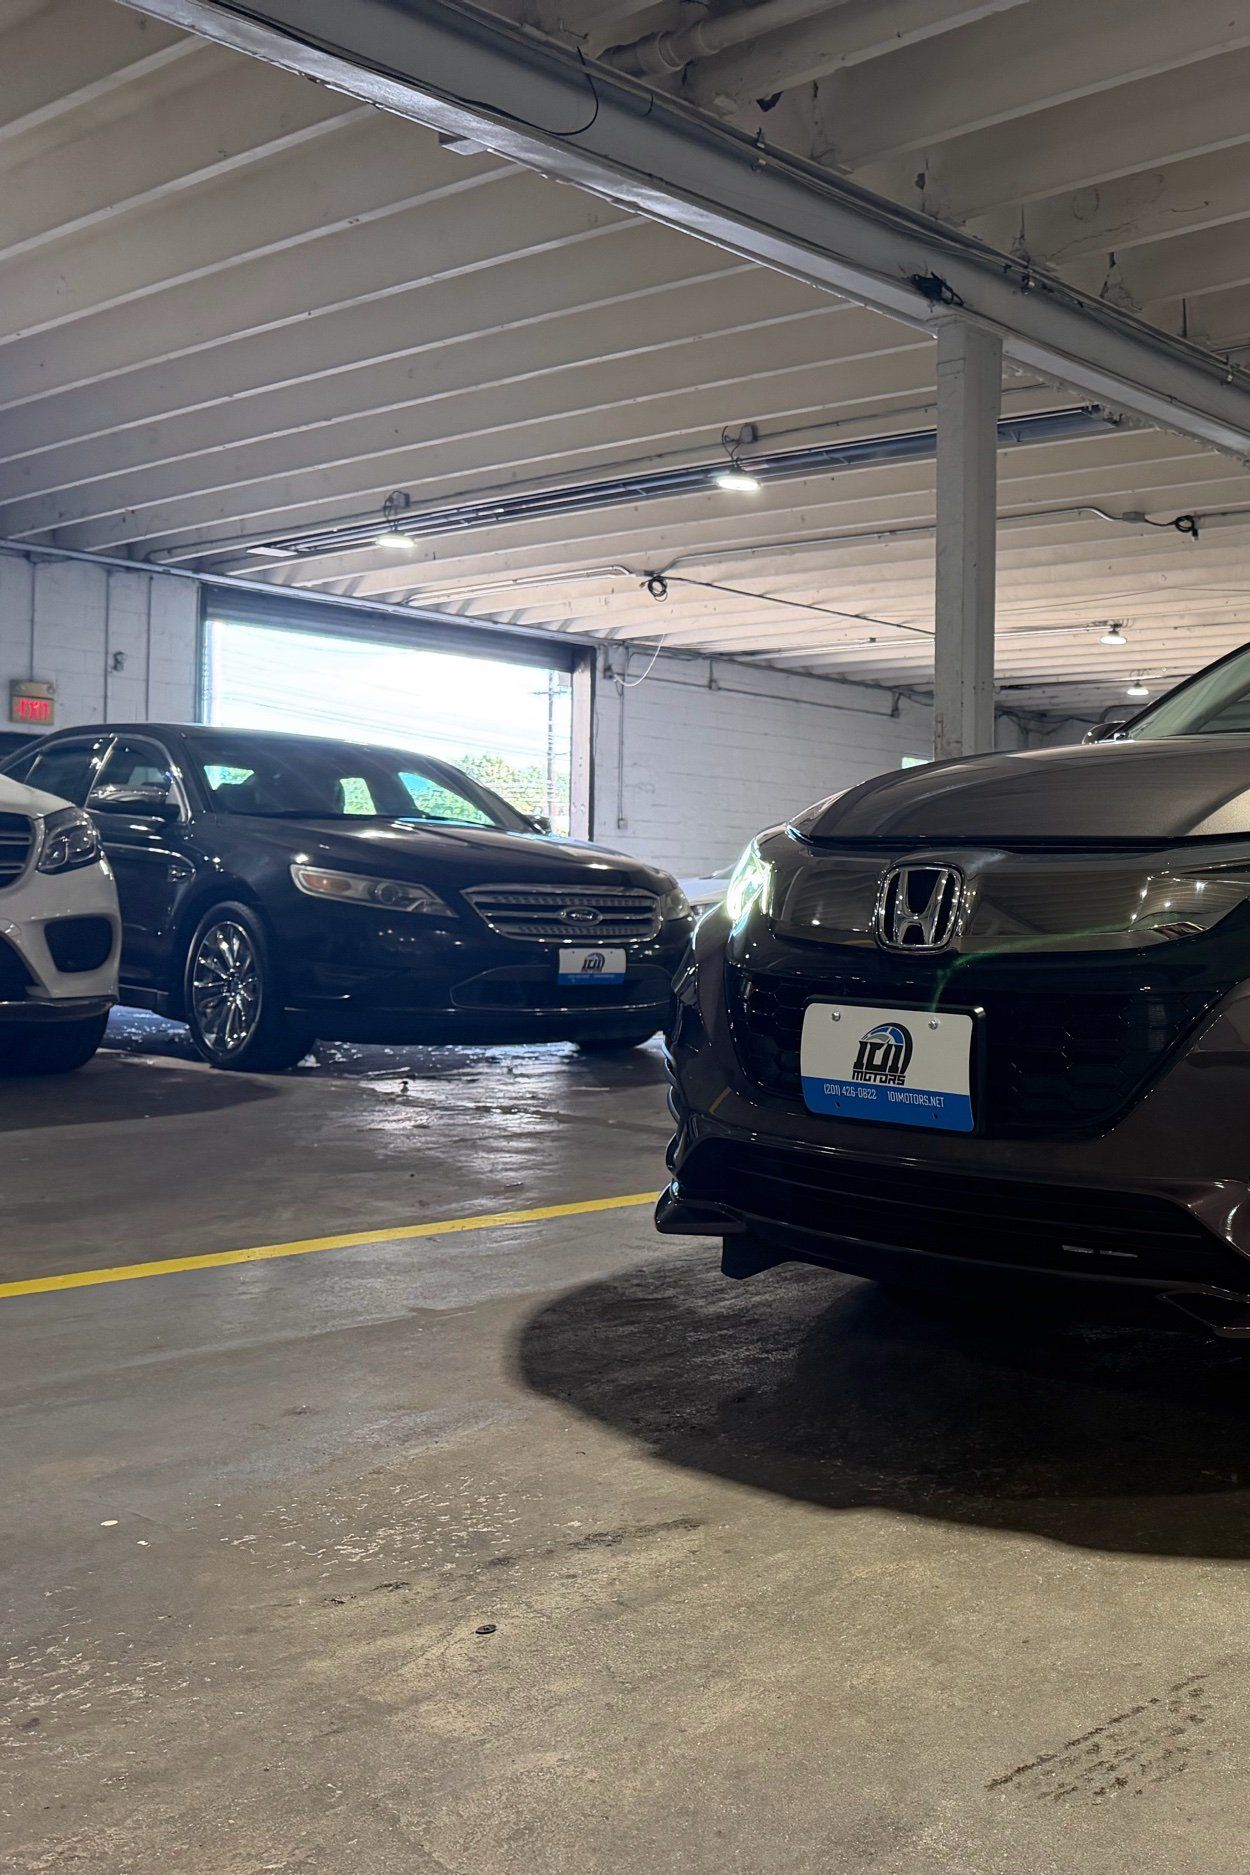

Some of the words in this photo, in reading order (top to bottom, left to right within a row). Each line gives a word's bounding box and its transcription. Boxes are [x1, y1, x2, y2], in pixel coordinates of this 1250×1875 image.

[852, 1069, 907, 1086] MOTORS
[823, 1083, 841, 1097] (201)
[841, 1085, 877, 1100] 426-0822
[887, 1090, 945, 1108] 101MOTORS.NET
